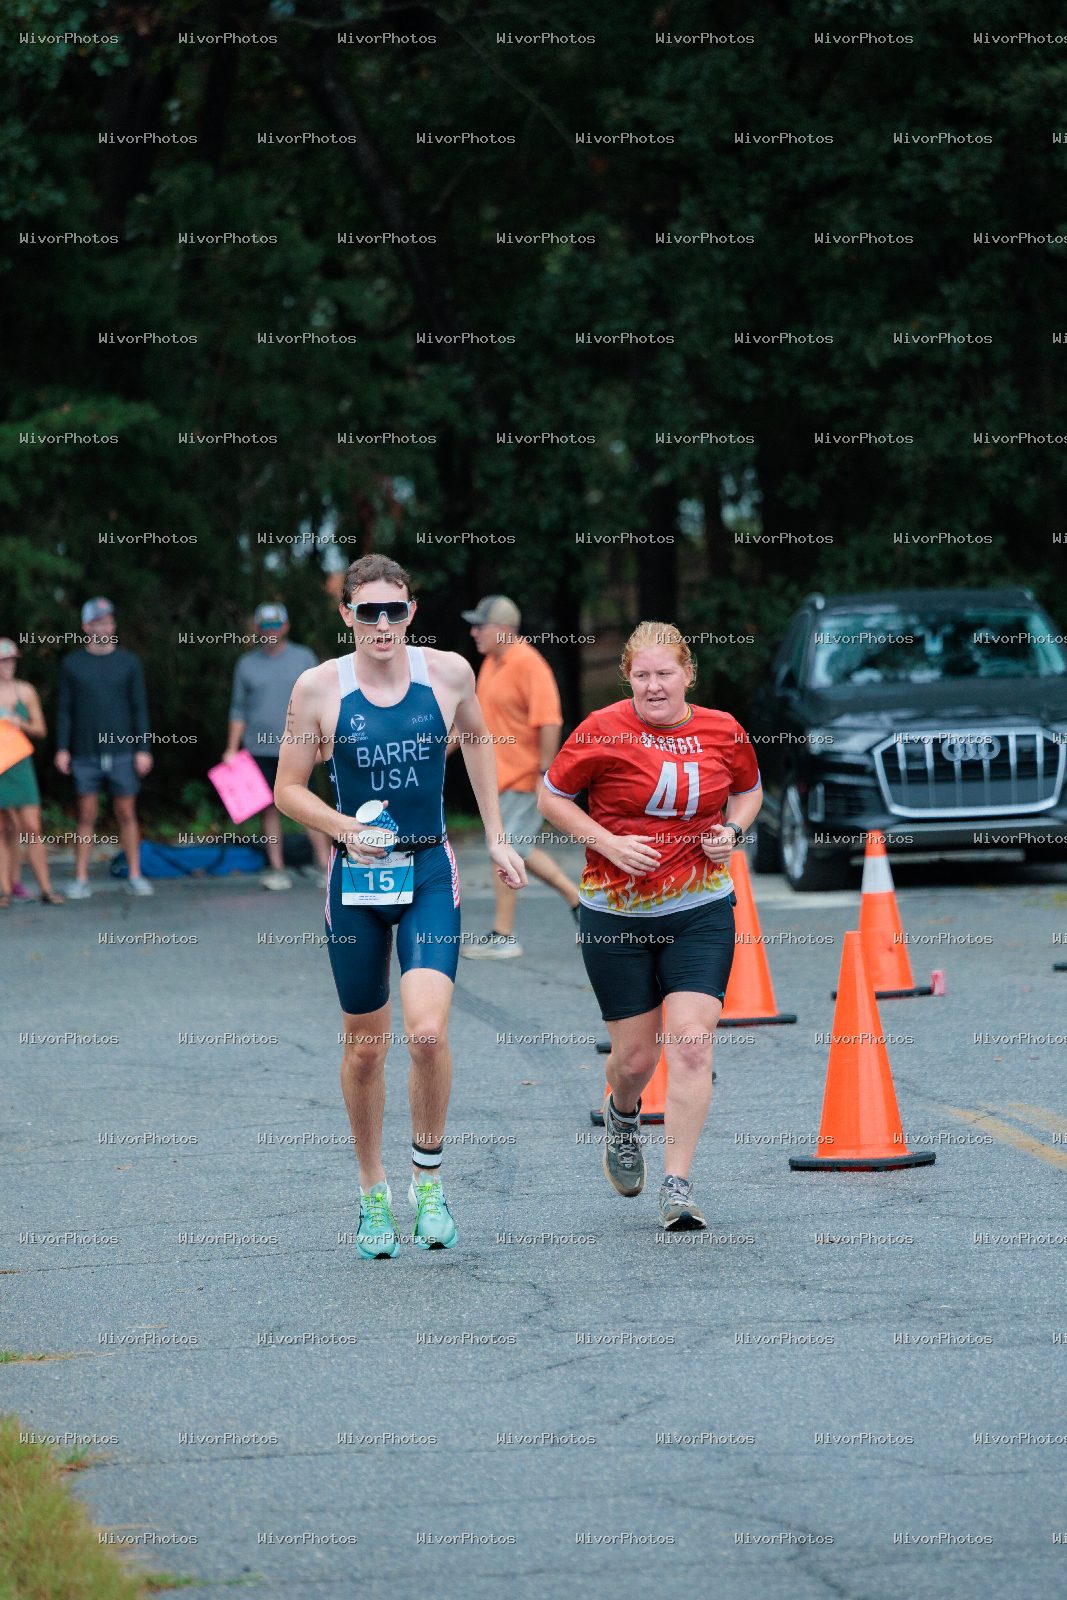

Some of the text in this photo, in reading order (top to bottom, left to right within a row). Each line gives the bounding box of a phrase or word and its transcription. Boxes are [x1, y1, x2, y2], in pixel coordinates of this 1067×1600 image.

[356, 738, 430, 768] BARRE
[370, 766, 419, 792] USA
[644, 760, 701, 822] 41
[363, 870, 395, 892] 15
